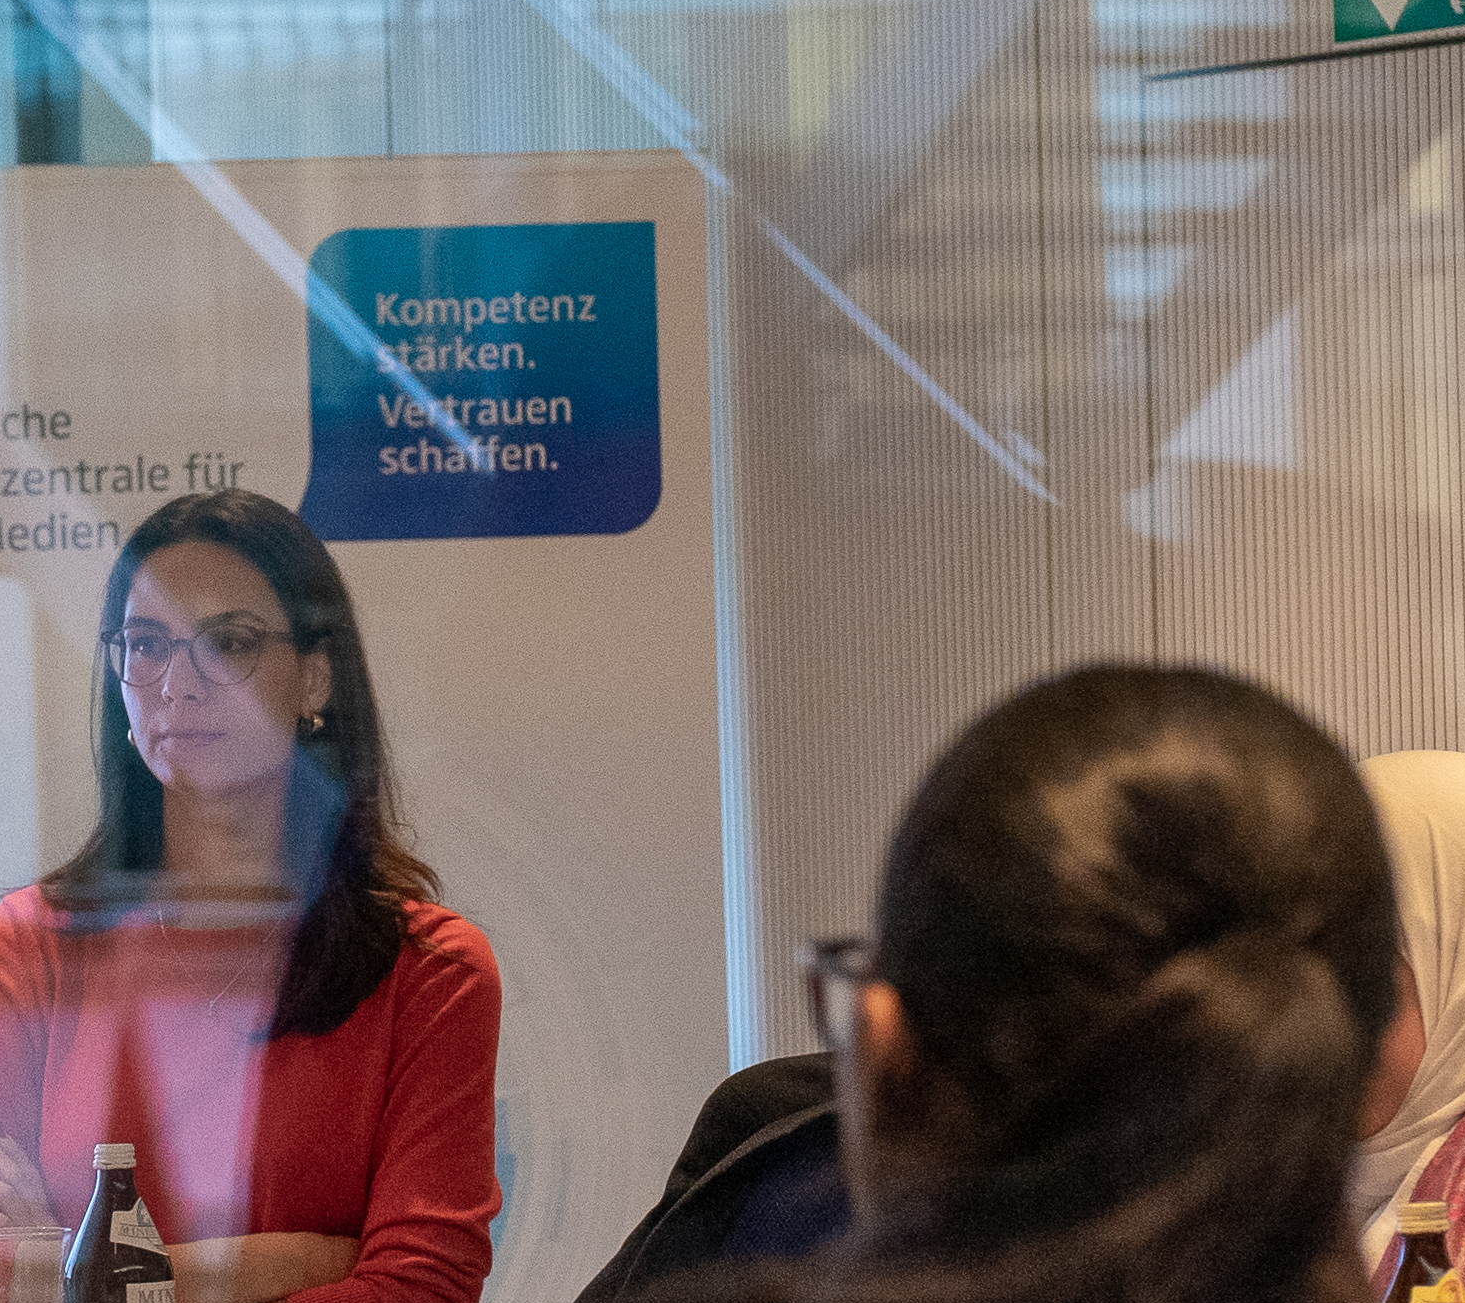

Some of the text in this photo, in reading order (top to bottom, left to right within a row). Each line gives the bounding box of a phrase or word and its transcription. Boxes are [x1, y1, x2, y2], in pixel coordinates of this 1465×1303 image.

[374, 291, 598, 333] Kompetenz
[375, 335, 537, 374] stärken.
[377, 393, 574, 429] Vertrauen
[183, 452, 246, 492] für
[378, 435, 560, 476] schaffen.
